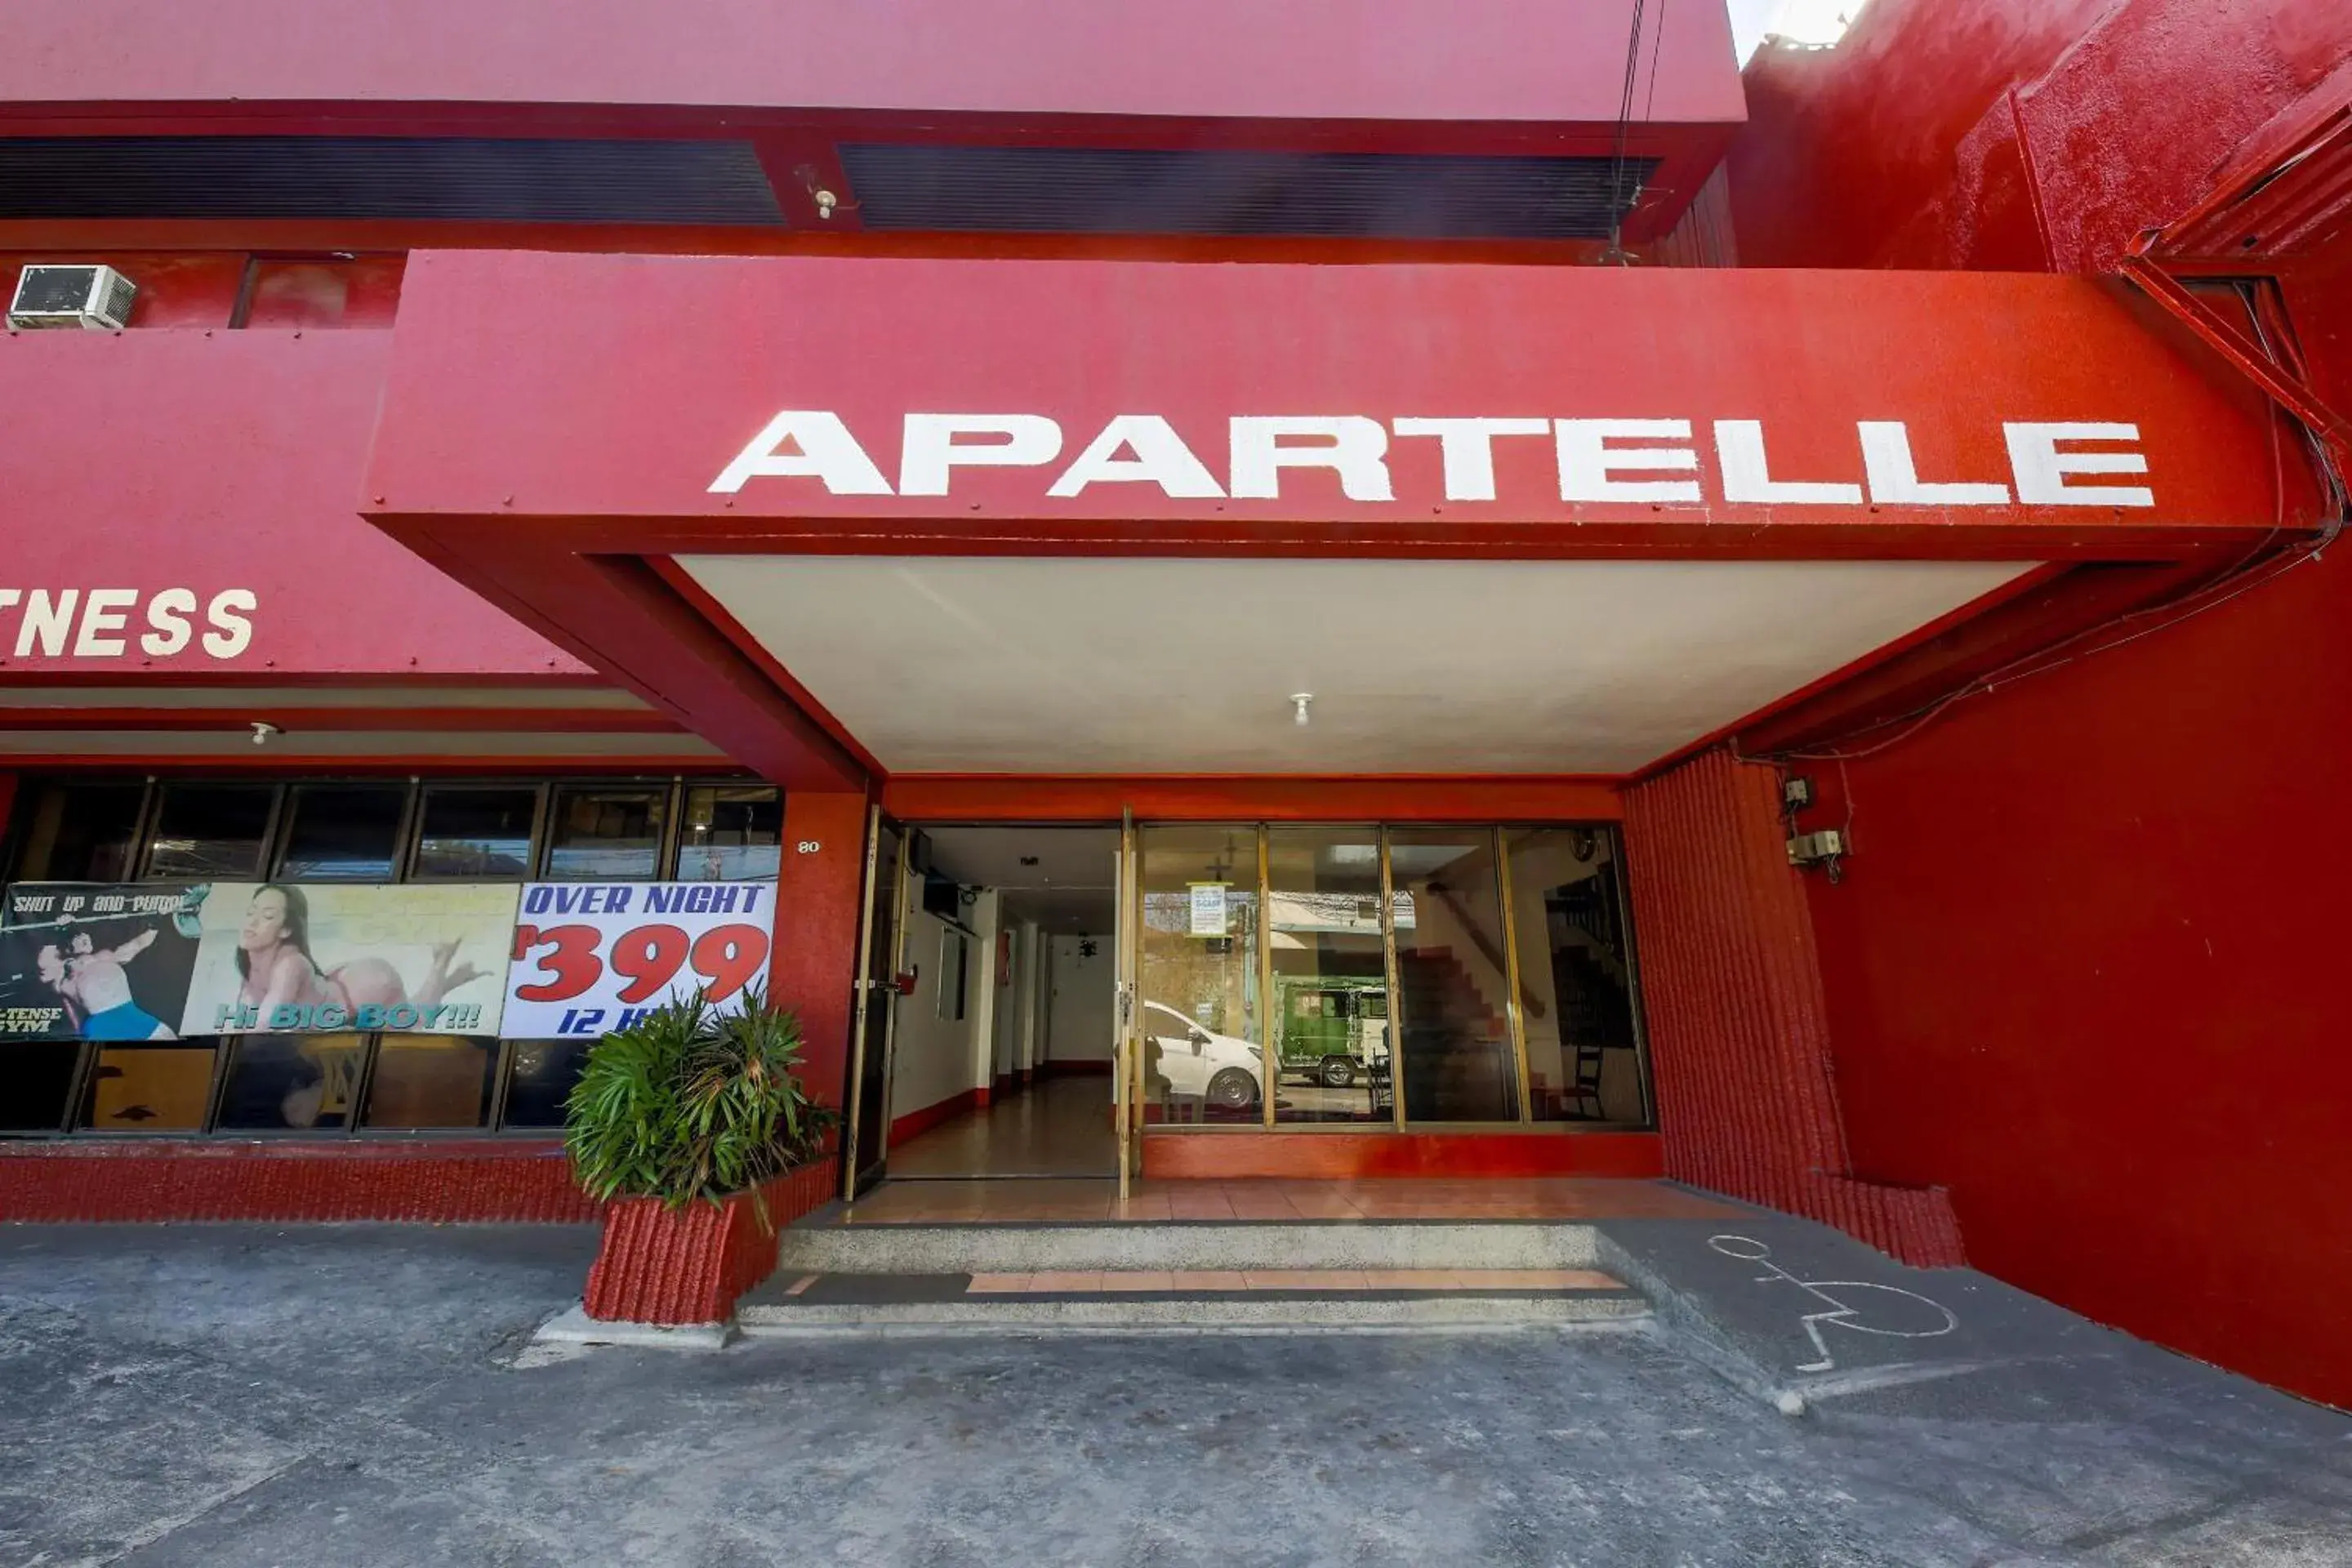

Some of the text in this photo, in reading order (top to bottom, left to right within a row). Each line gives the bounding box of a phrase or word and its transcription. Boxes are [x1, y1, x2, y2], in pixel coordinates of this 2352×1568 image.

[706, 410, 2155, 507] APARTELLE
[798, 841, 820, 853] 80
[14, 896, 56, 912] SHUT
[62, 896, 85, 912] UP
[524, 884, 766, 914] OVER NIGHT
[269, 1003, 347, 1030] BIG
[354, 1003, 482, 1030] BOY!!!
[557, 1009, 605, 1034] 12
